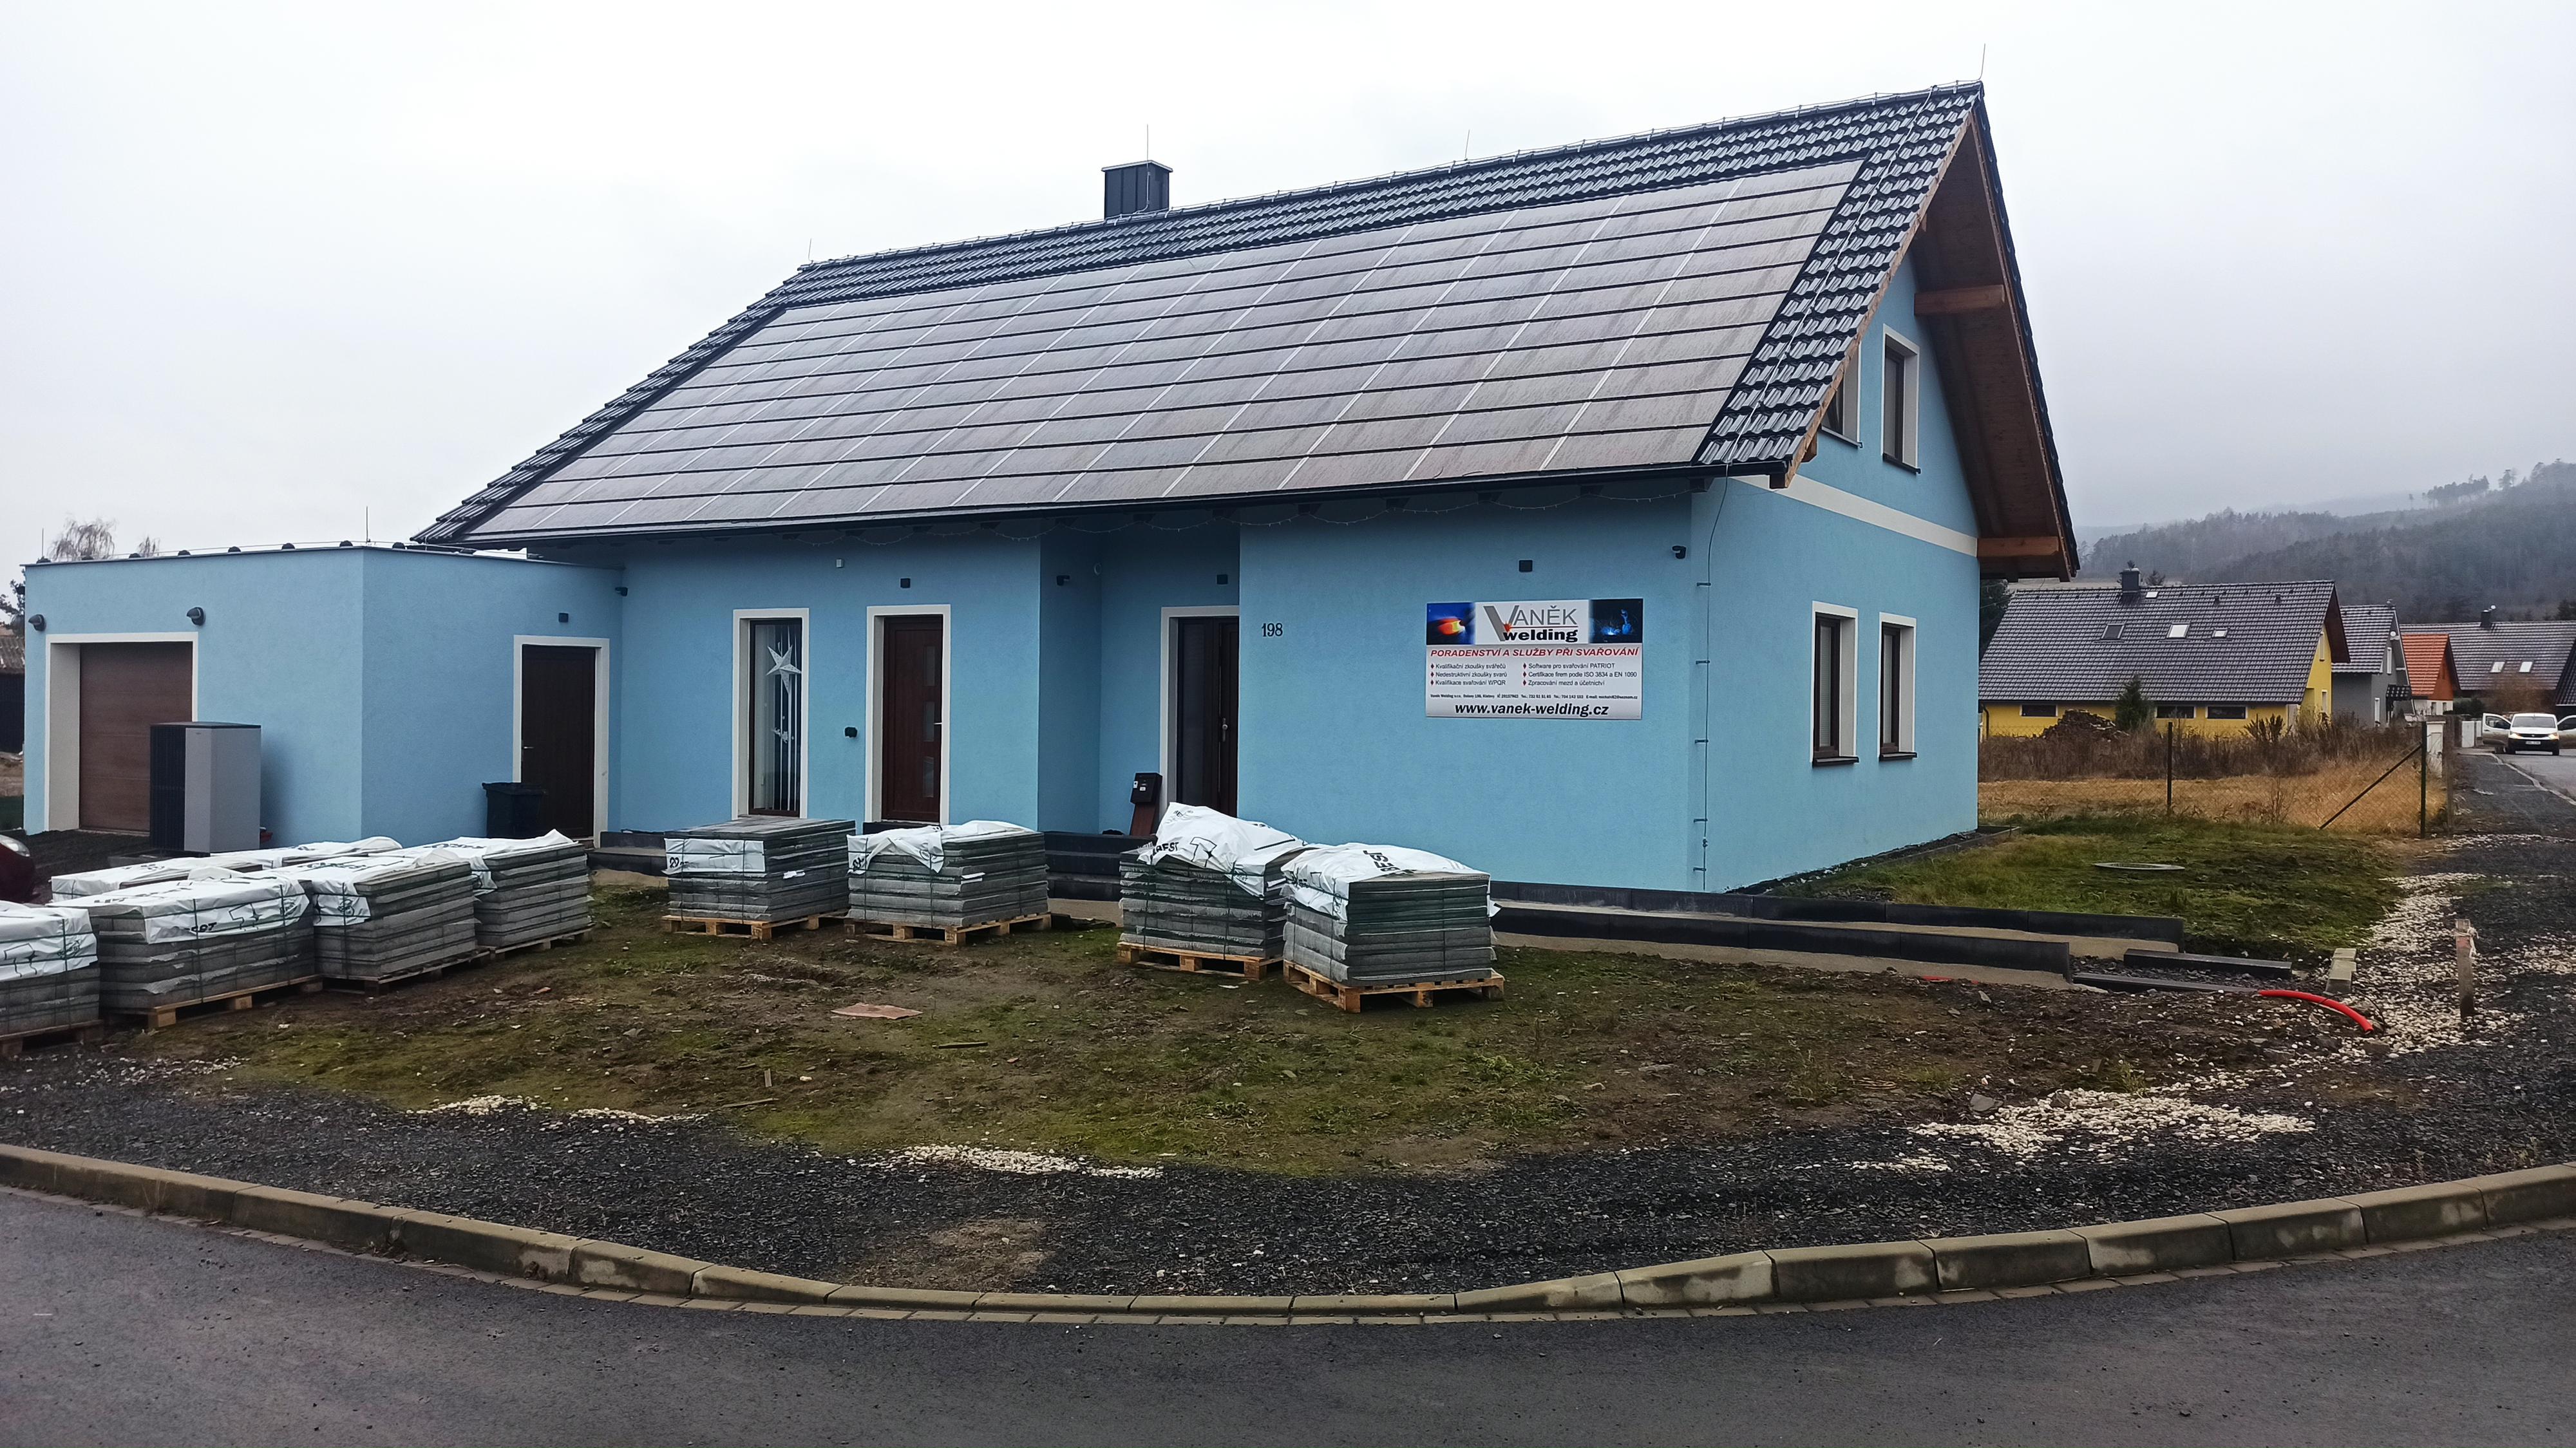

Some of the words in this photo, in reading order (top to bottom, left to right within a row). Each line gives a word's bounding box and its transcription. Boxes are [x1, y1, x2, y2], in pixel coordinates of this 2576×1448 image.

[1262, 623, 1283, 637] 198
[1483, 605, 1577, 641] VANĚK
[1503, 629, 1578, 643] welding
[1430, 648, 1501, 657] PORADENSTVÍ
[1513, 648, 1553, 656] SLUŽBY
[1555, 648, 1573, 656] PŘI
[1576, 648, 1639, 656] SVAŘOVÁNÍ
[1455, 703, 1609, 717] www.vanek-welding.cz
